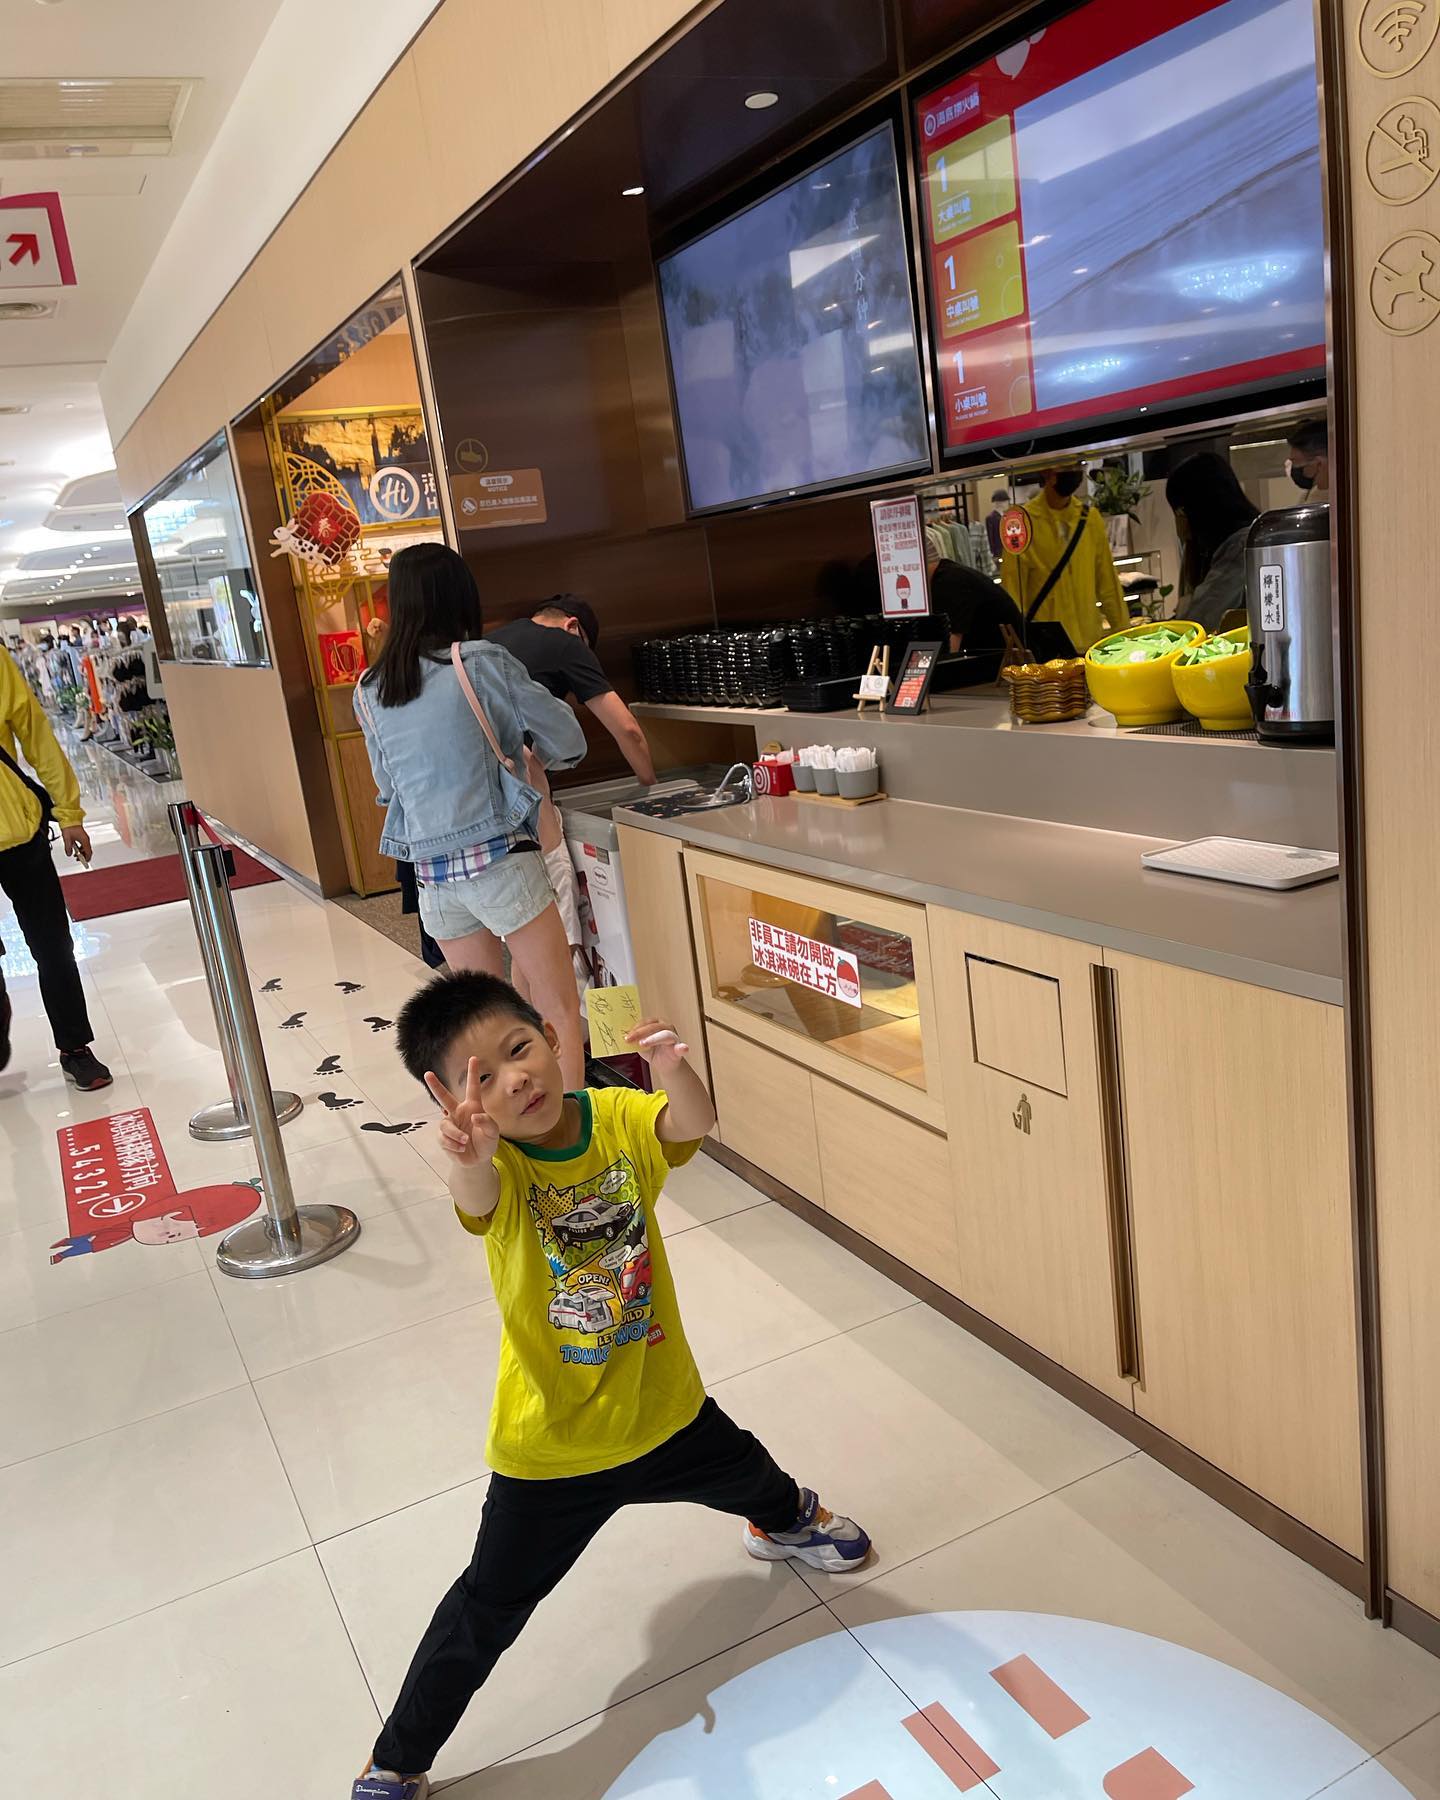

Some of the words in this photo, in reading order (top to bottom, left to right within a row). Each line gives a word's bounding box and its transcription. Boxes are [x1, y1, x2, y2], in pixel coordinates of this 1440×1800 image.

[936, 156, 948, 192] 1
[944, 255, 956, 290] 1
[953, 350, 965, 384] 1
[750, 920, 836, 971] 非員工請勿開啟
[753, 944, 838, 997] 冰淇淋碗在上方
[577, 1274, 610, 1286] OPEN!
[560, 1345, 610, 1364] TOMIC
